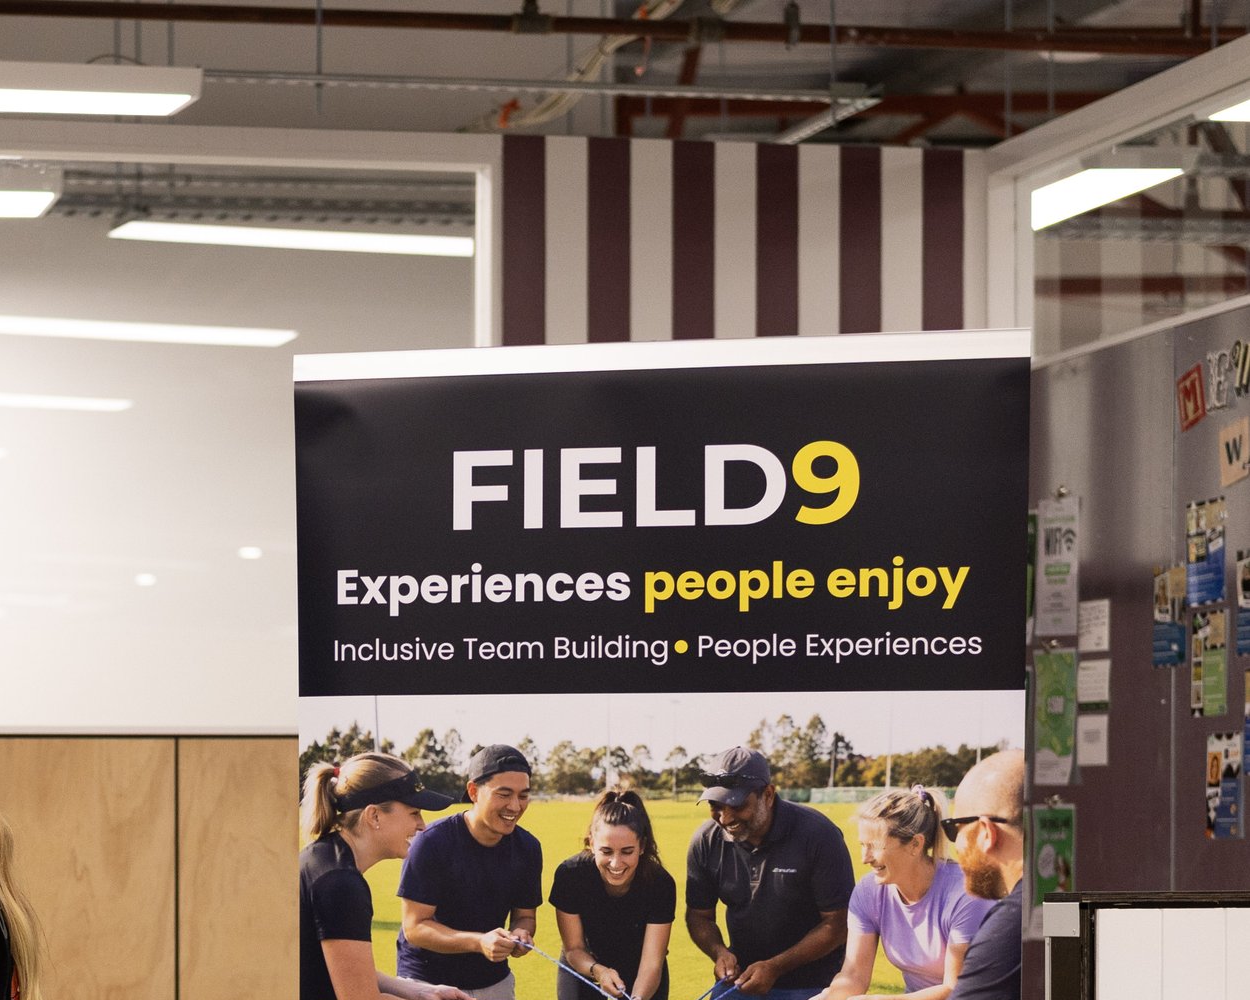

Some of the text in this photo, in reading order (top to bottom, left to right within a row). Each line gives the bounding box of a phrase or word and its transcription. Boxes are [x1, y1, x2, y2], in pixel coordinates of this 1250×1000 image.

[453, 441, 861, 531] FIELD9
[337, 556, 971, 617] Experiences people enjoy
[335, 632, 983, 666] Inclusive Team Building People Experiences
